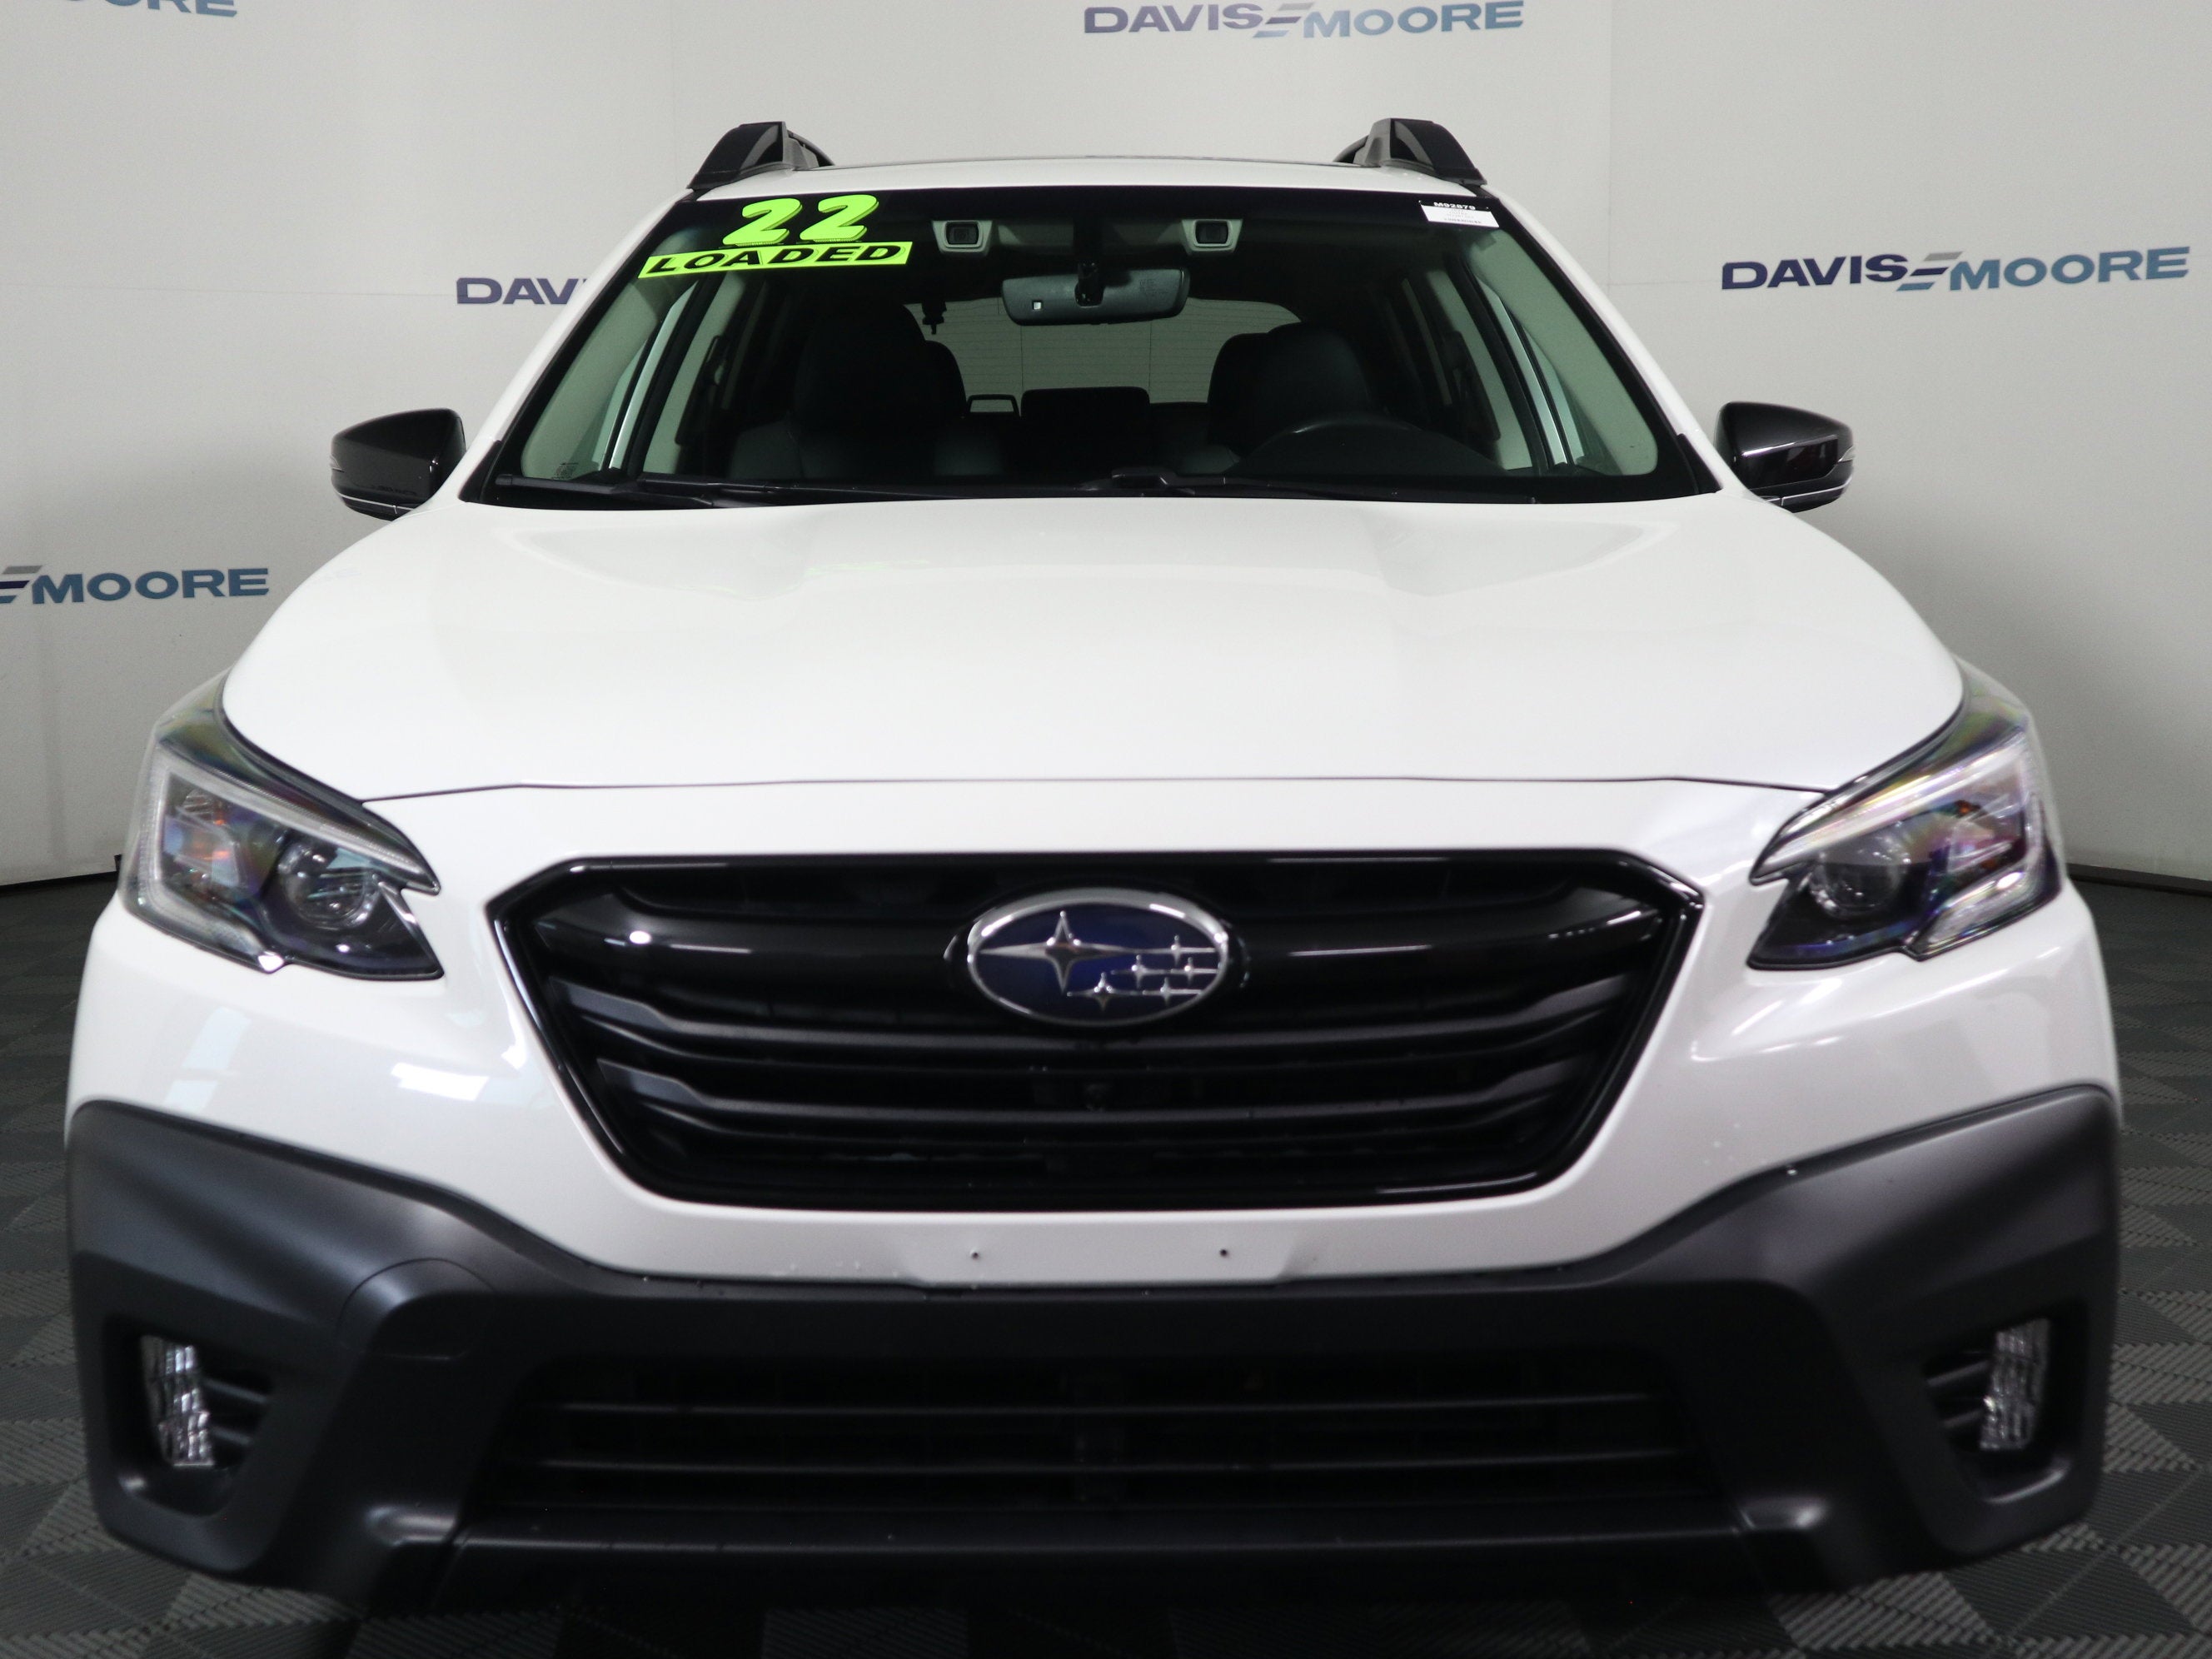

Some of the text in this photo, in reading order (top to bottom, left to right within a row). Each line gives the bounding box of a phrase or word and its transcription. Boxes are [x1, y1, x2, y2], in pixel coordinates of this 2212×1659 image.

[1084, 1, 1524, 38] DAVIS MOORE
[722, 194, 879, 246] 22
[645, 245, 906, 274] LOADED
[1721, 247, 2190, 291] DAVIS MOORE
[456, 277, 586, 305] DAV
[32, 568, 269, 605] MOORE
